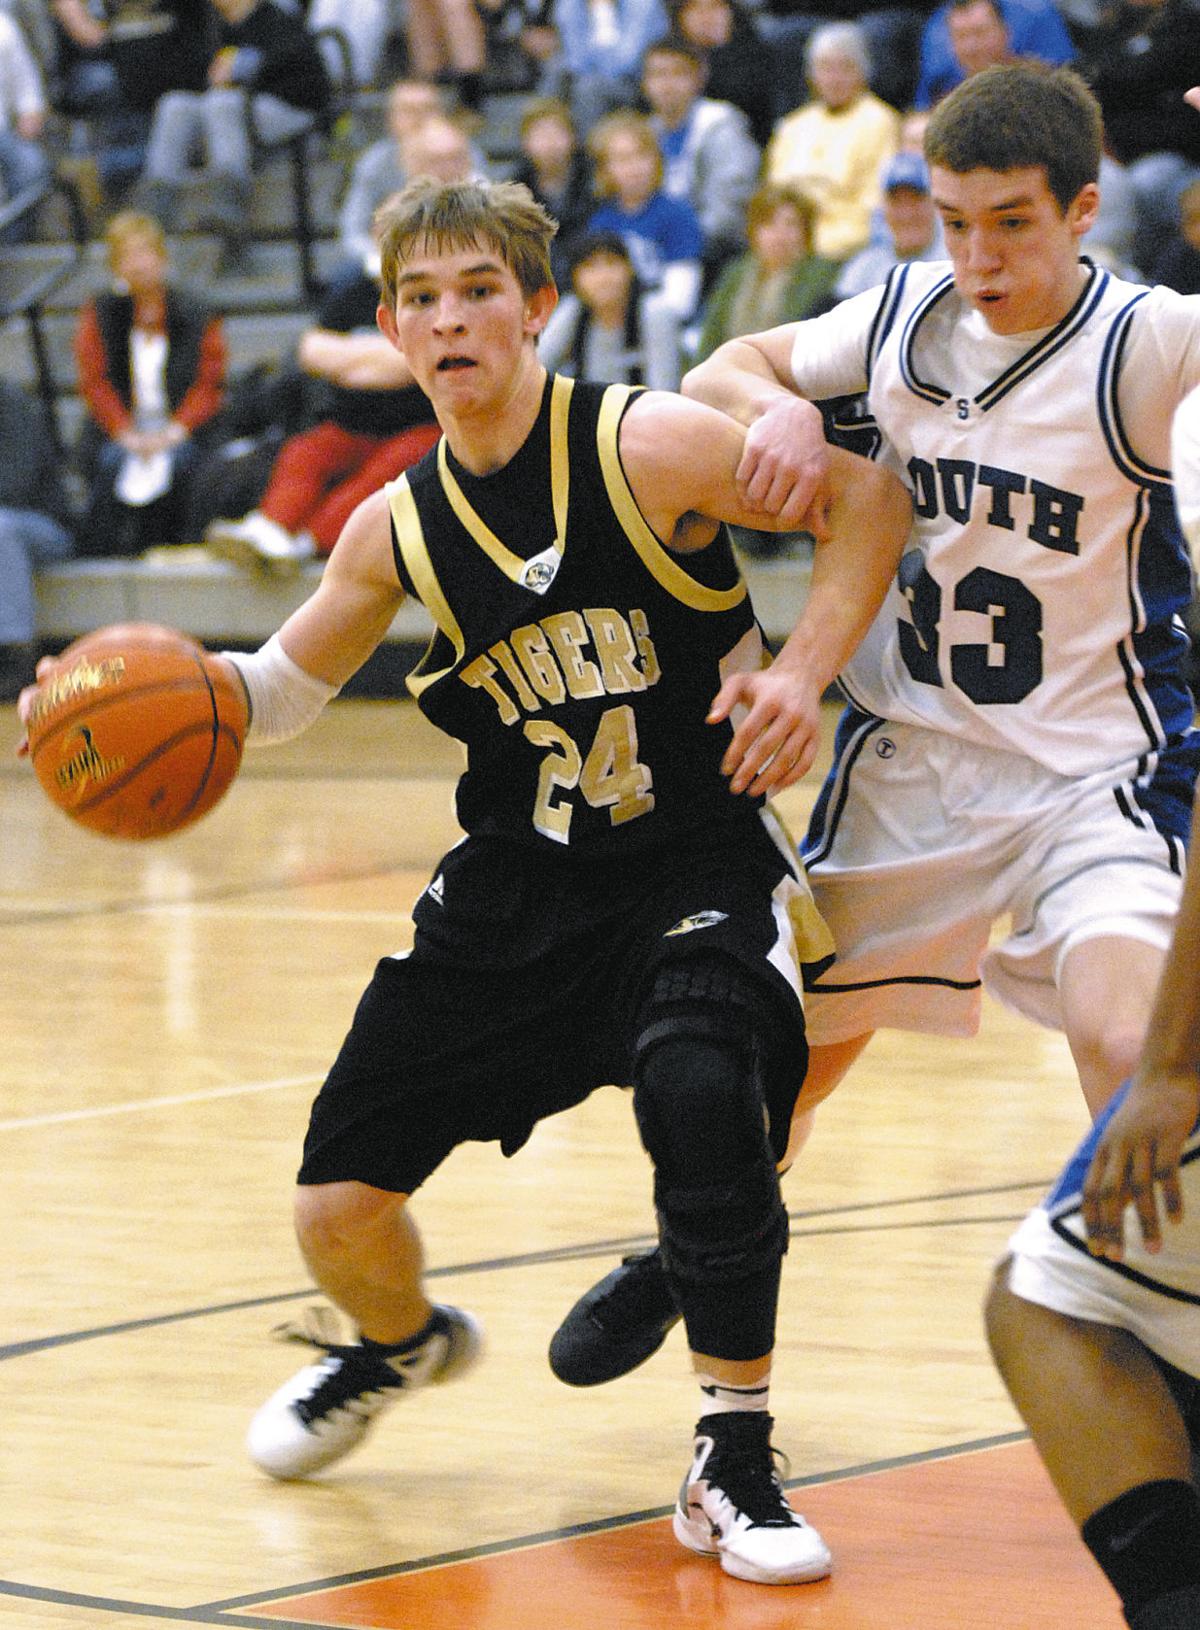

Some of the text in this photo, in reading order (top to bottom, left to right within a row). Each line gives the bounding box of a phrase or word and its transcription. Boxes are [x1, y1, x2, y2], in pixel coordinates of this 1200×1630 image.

[956, 398, 969, 420] S
[907, 456, 1085, 556] OUTH
[458, 607, 662, 727] TIGERS
[897, 548, 1044, 705] 33
[522, 704, 656, 846] 24
